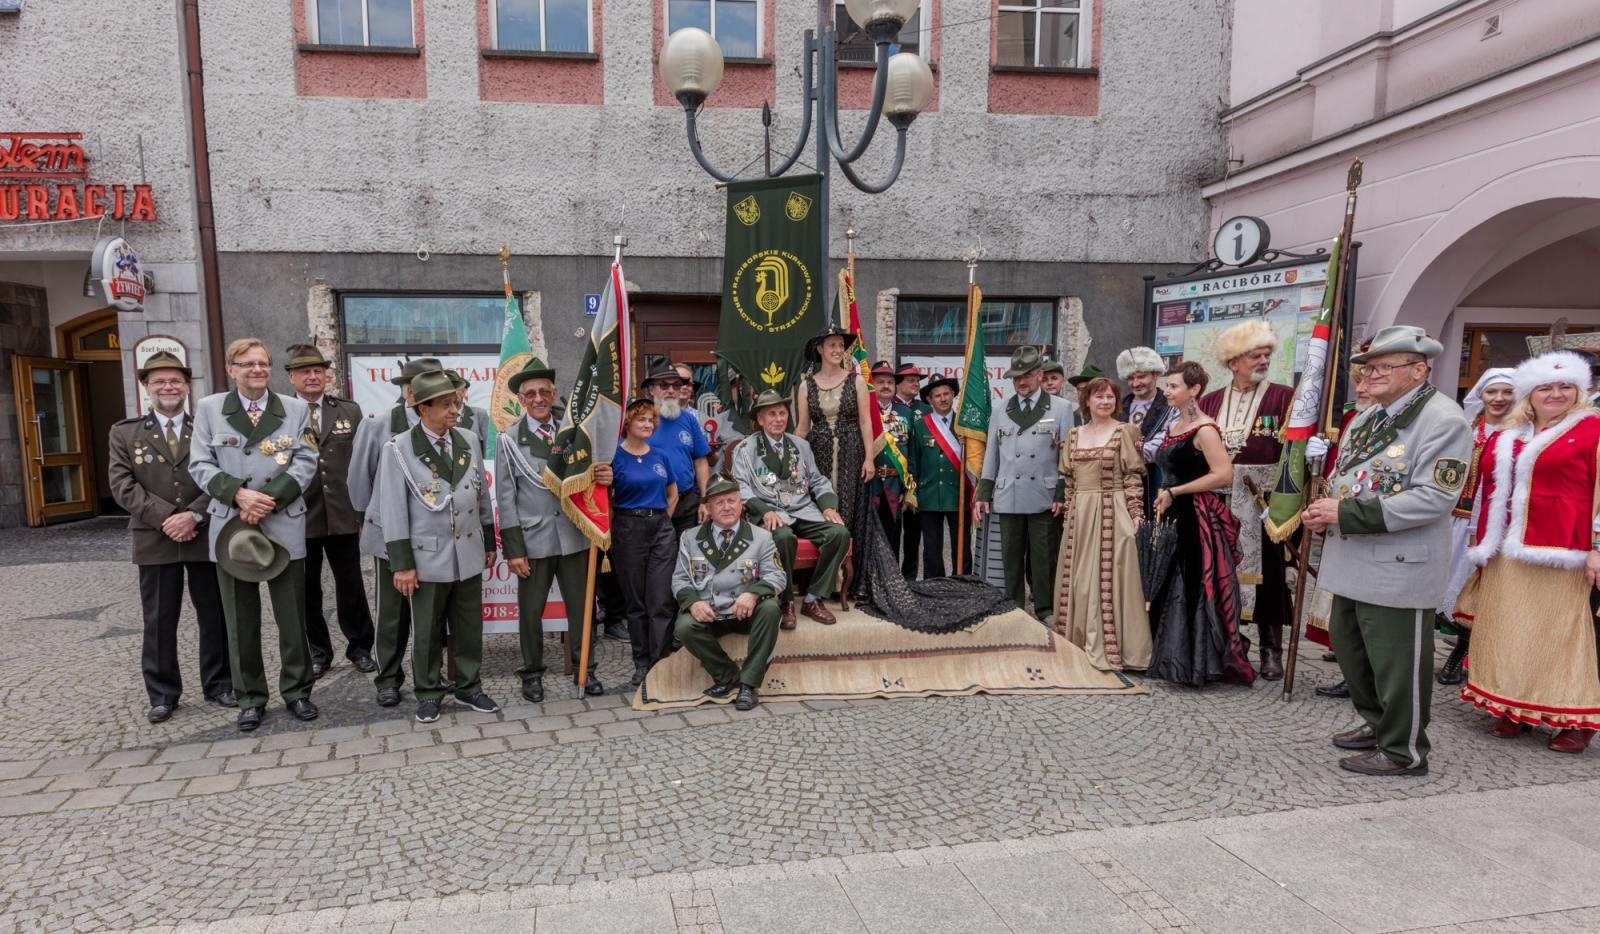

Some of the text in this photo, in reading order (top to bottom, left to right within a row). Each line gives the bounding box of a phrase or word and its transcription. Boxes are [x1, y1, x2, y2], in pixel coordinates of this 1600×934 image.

[1202, 271, 1283, 292] RACIBÓRZ
[588, 296, 597, 310] 9
[366, 367, 392, 382] TU
